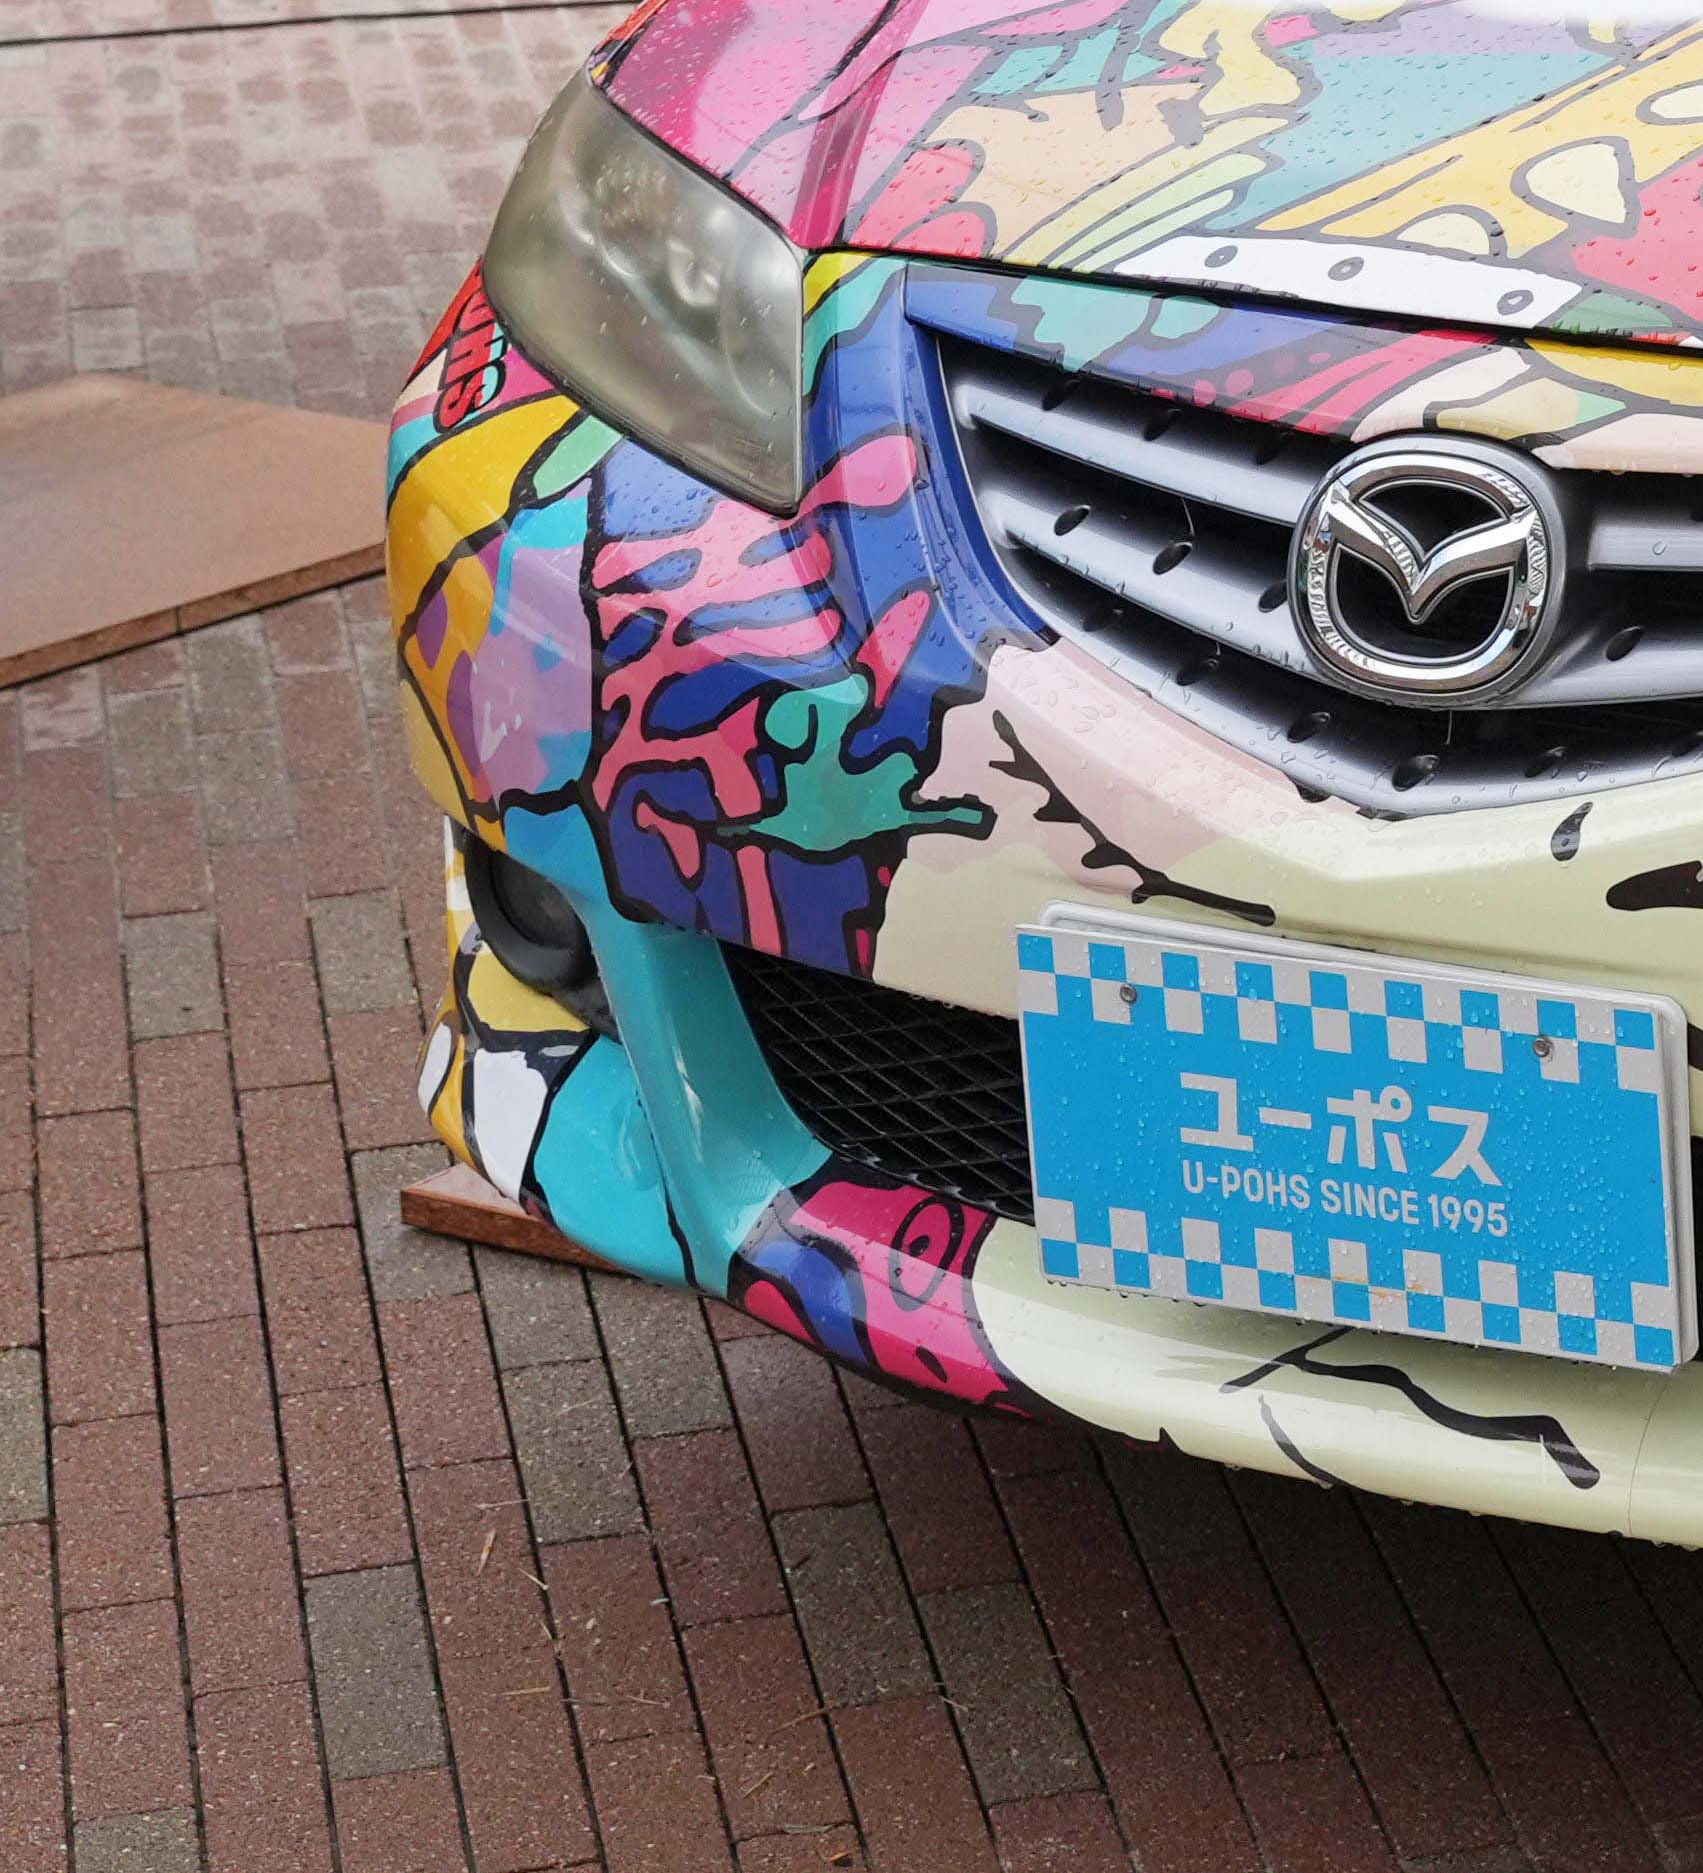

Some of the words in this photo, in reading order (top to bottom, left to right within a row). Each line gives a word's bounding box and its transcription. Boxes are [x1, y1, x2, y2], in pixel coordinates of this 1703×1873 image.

[1180, 1071, 1504, 1187] ユーポス
[1182, 1159, 1311, 1211] U-POHS
[1320, 1181, 1420, 1225] SINCE
[1427, 1195, 1509, 1239] 1995
